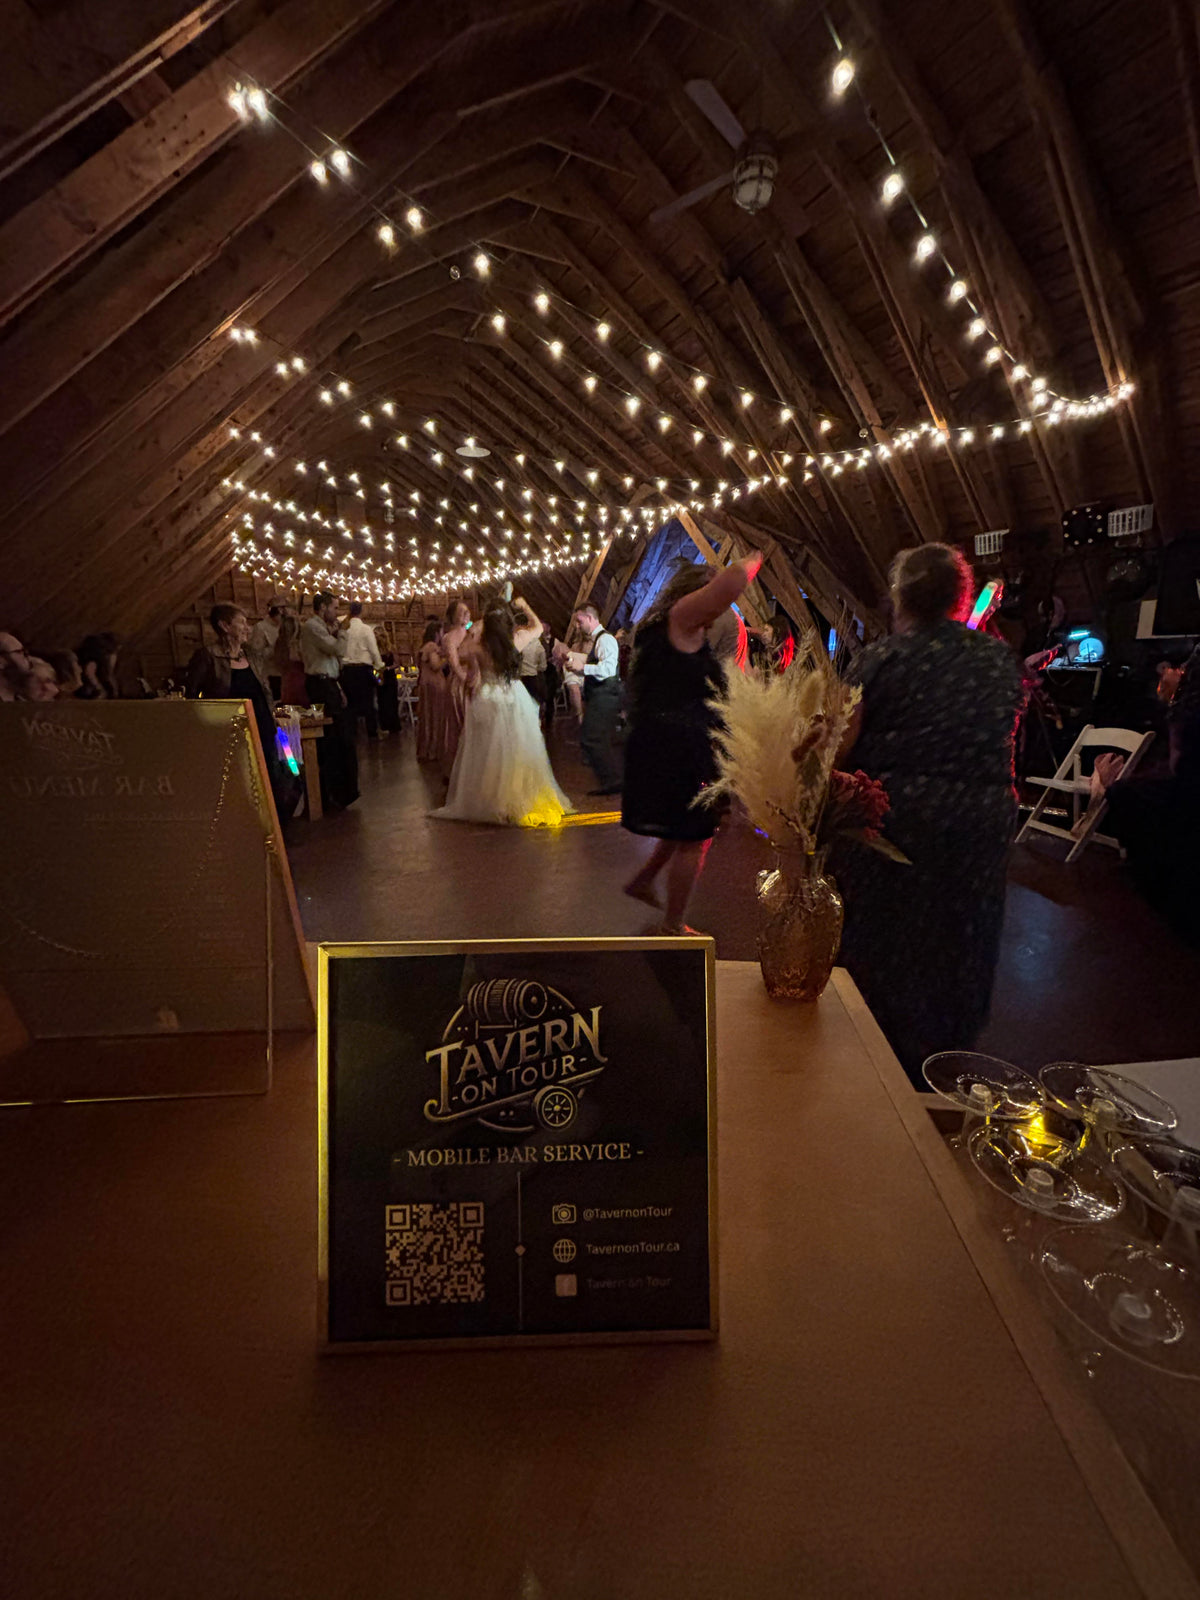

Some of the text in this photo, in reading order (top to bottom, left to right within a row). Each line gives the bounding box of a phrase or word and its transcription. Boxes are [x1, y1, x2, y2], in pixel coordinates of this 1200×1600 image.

[425, 1006, 608, 1114] TAVERN
[407, 1143, 631, 1166] MOBILE BAR SERVICE
[583, 1206, 672, 1221] @TavernonTour
[586, 1242, 680, 1255] TavernonTour.ca
